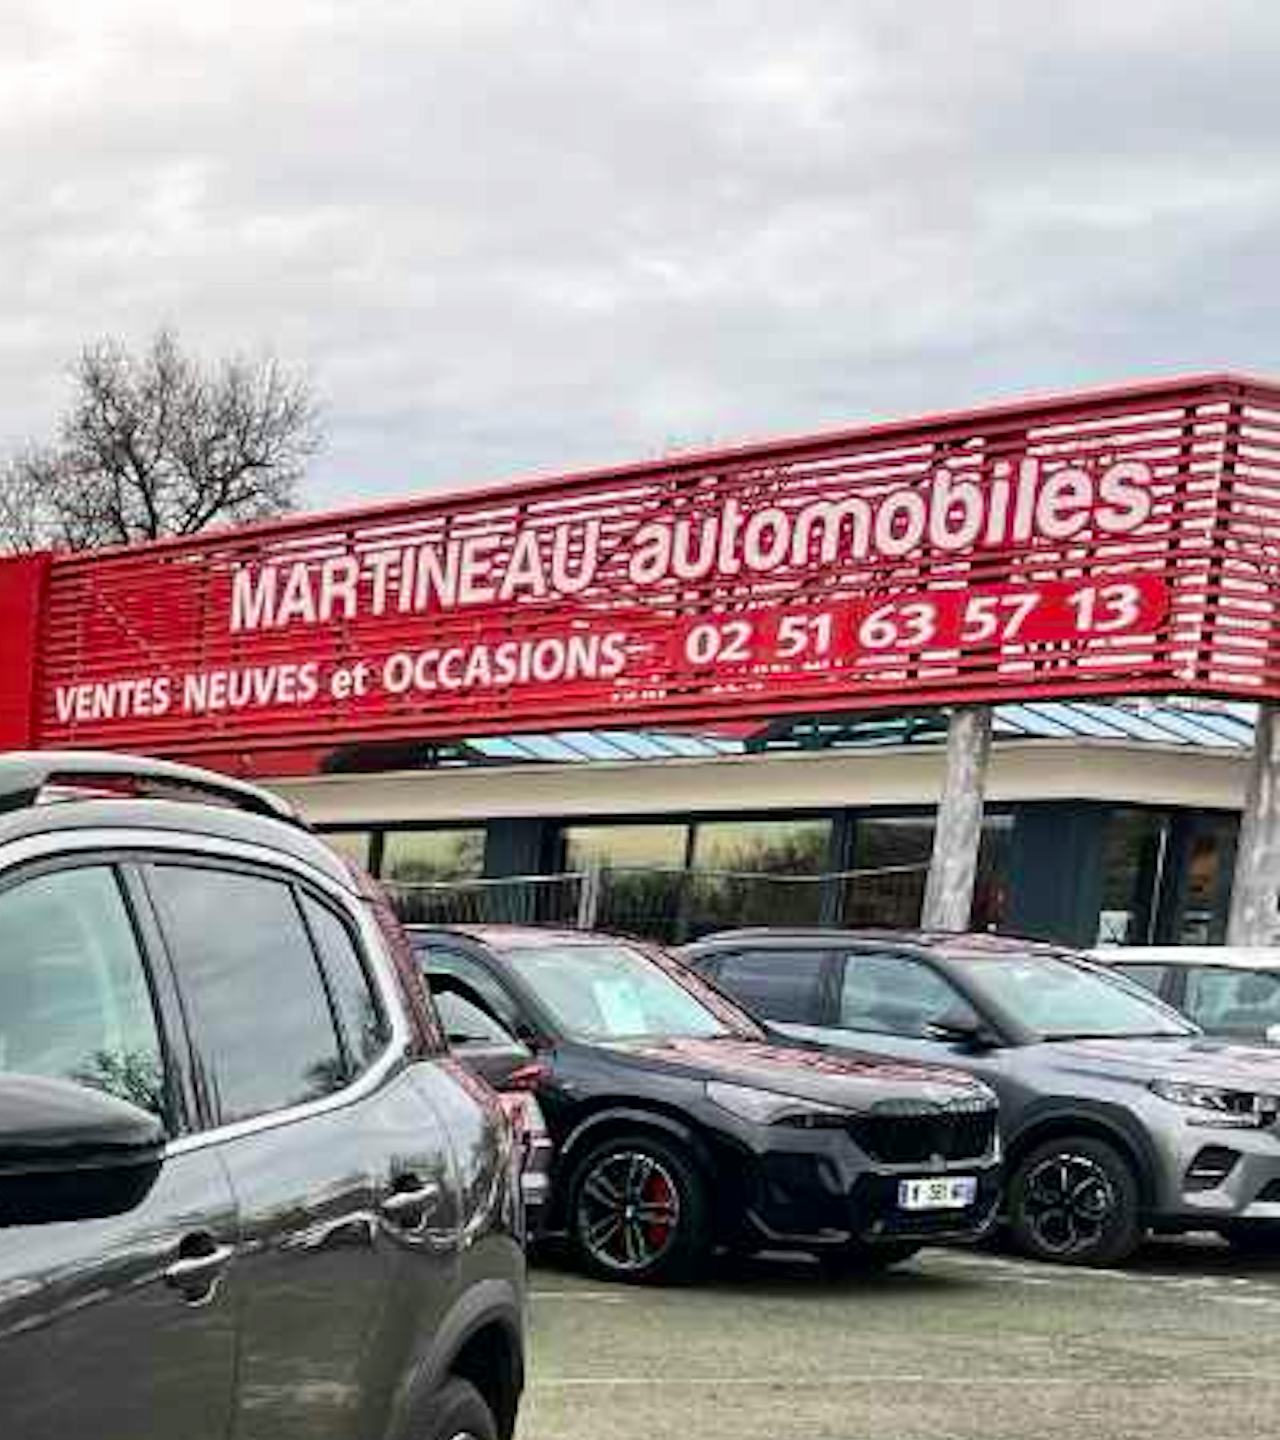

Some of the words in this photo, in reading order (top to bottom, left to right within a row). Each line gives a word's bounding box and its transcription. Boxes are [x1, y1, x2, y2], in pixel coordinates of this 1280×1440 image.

[229, 518, 601, 634] MARTINEAU
[628, 457, 1152, 584] automobiles
[54, 676, 170, 722] VENTES
[183, 662, 319, 714] NEUVES
[330, 662, 369, 700] et
[381, 631, 627, 694] OCCASIONS
[685, 621, 753, 666] 02
[775, 613, 832, 659] 51
[858, 602, 938, 650] 63
[959, 592, 1040, 642] 57
[1068, 582, 1141, 632] 13
